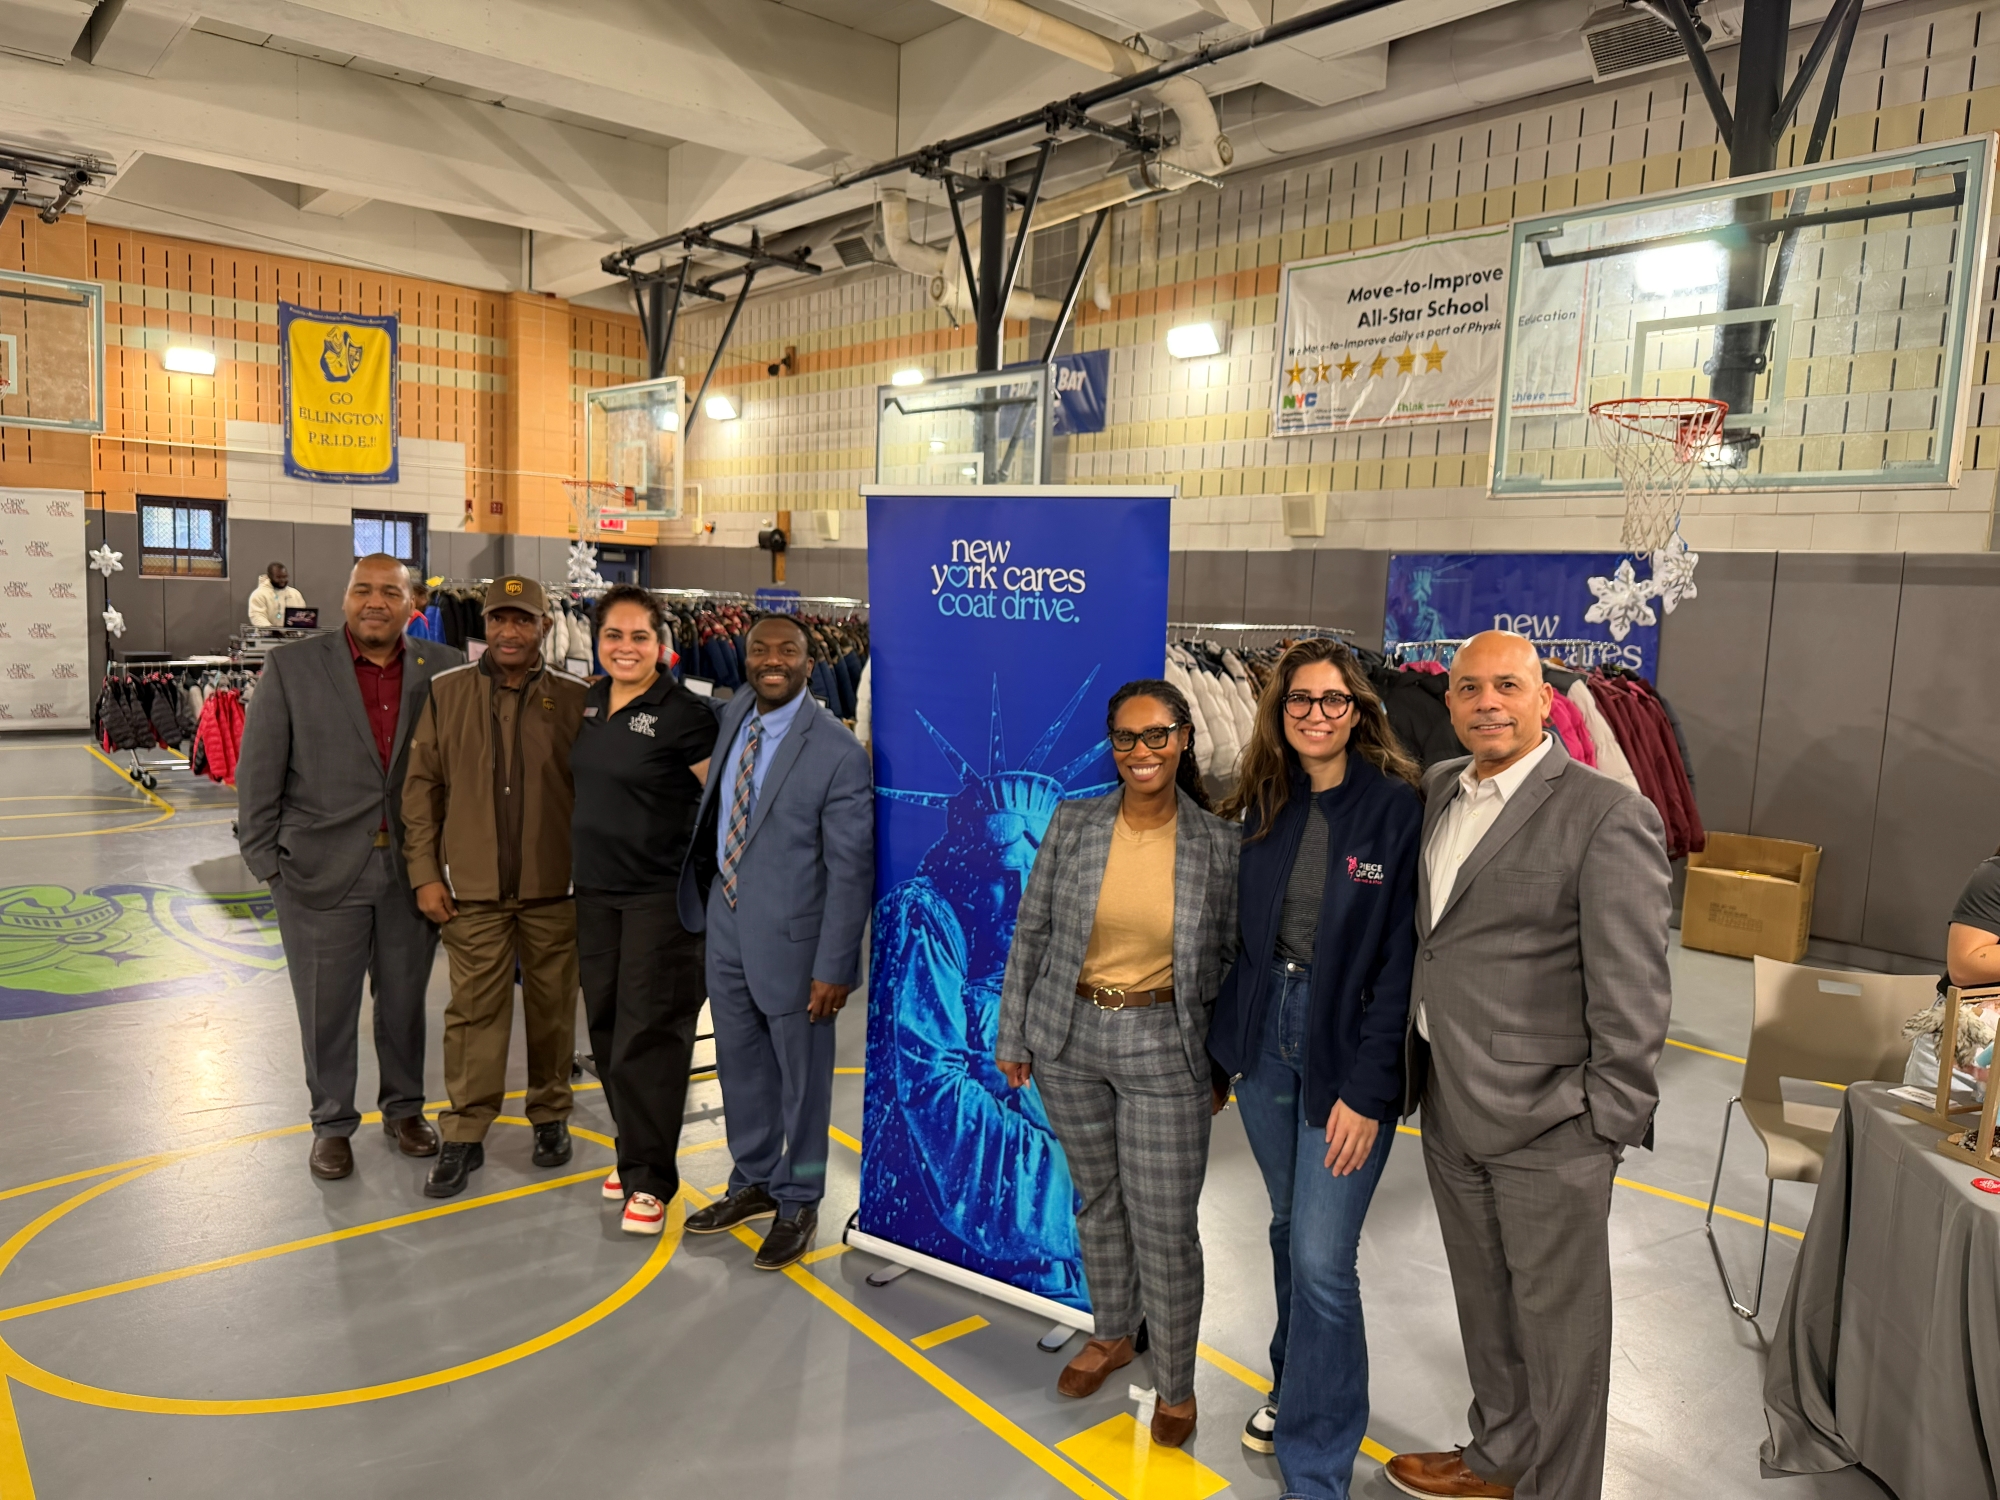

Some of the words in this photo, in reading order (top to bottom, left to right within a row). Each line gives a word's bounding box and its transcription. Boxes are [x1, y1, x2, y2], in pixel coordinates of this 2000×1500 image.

[1347, 267, 1504, 304] Move-to-Improve
[1357, 307, 1423, 329] All-Star
[1427, 293, 1490, 318] School
[1388, 326, 1413, 342] daily
[1426, 325, 1451, 340] part
[1453, 322, 1467, 334] of
[1467, 319, 1502, 335] Physic
[1518, 309, 1577, 327] Education
[1057, 367, 1087, 391] BAT
[329, 391, 353, 405] GO
[1282, 392, 1318, 409] NYC
[1512, 392, 1545, 402] hieve
[299, 406, 383, 425] ELLINGTON
[951, 538, 1011, 563] new
[1003, 566, 1086, 594] cares
[938, 590, 998, 618] coat
[1001, 588, 1080, 623] drive.
[1493, 613, 1560, 639] new
[1550, 644, 1643, 670] cares
[1355, 869, 1367, 878] OF
[1367, 871, 1384, 880] CA
